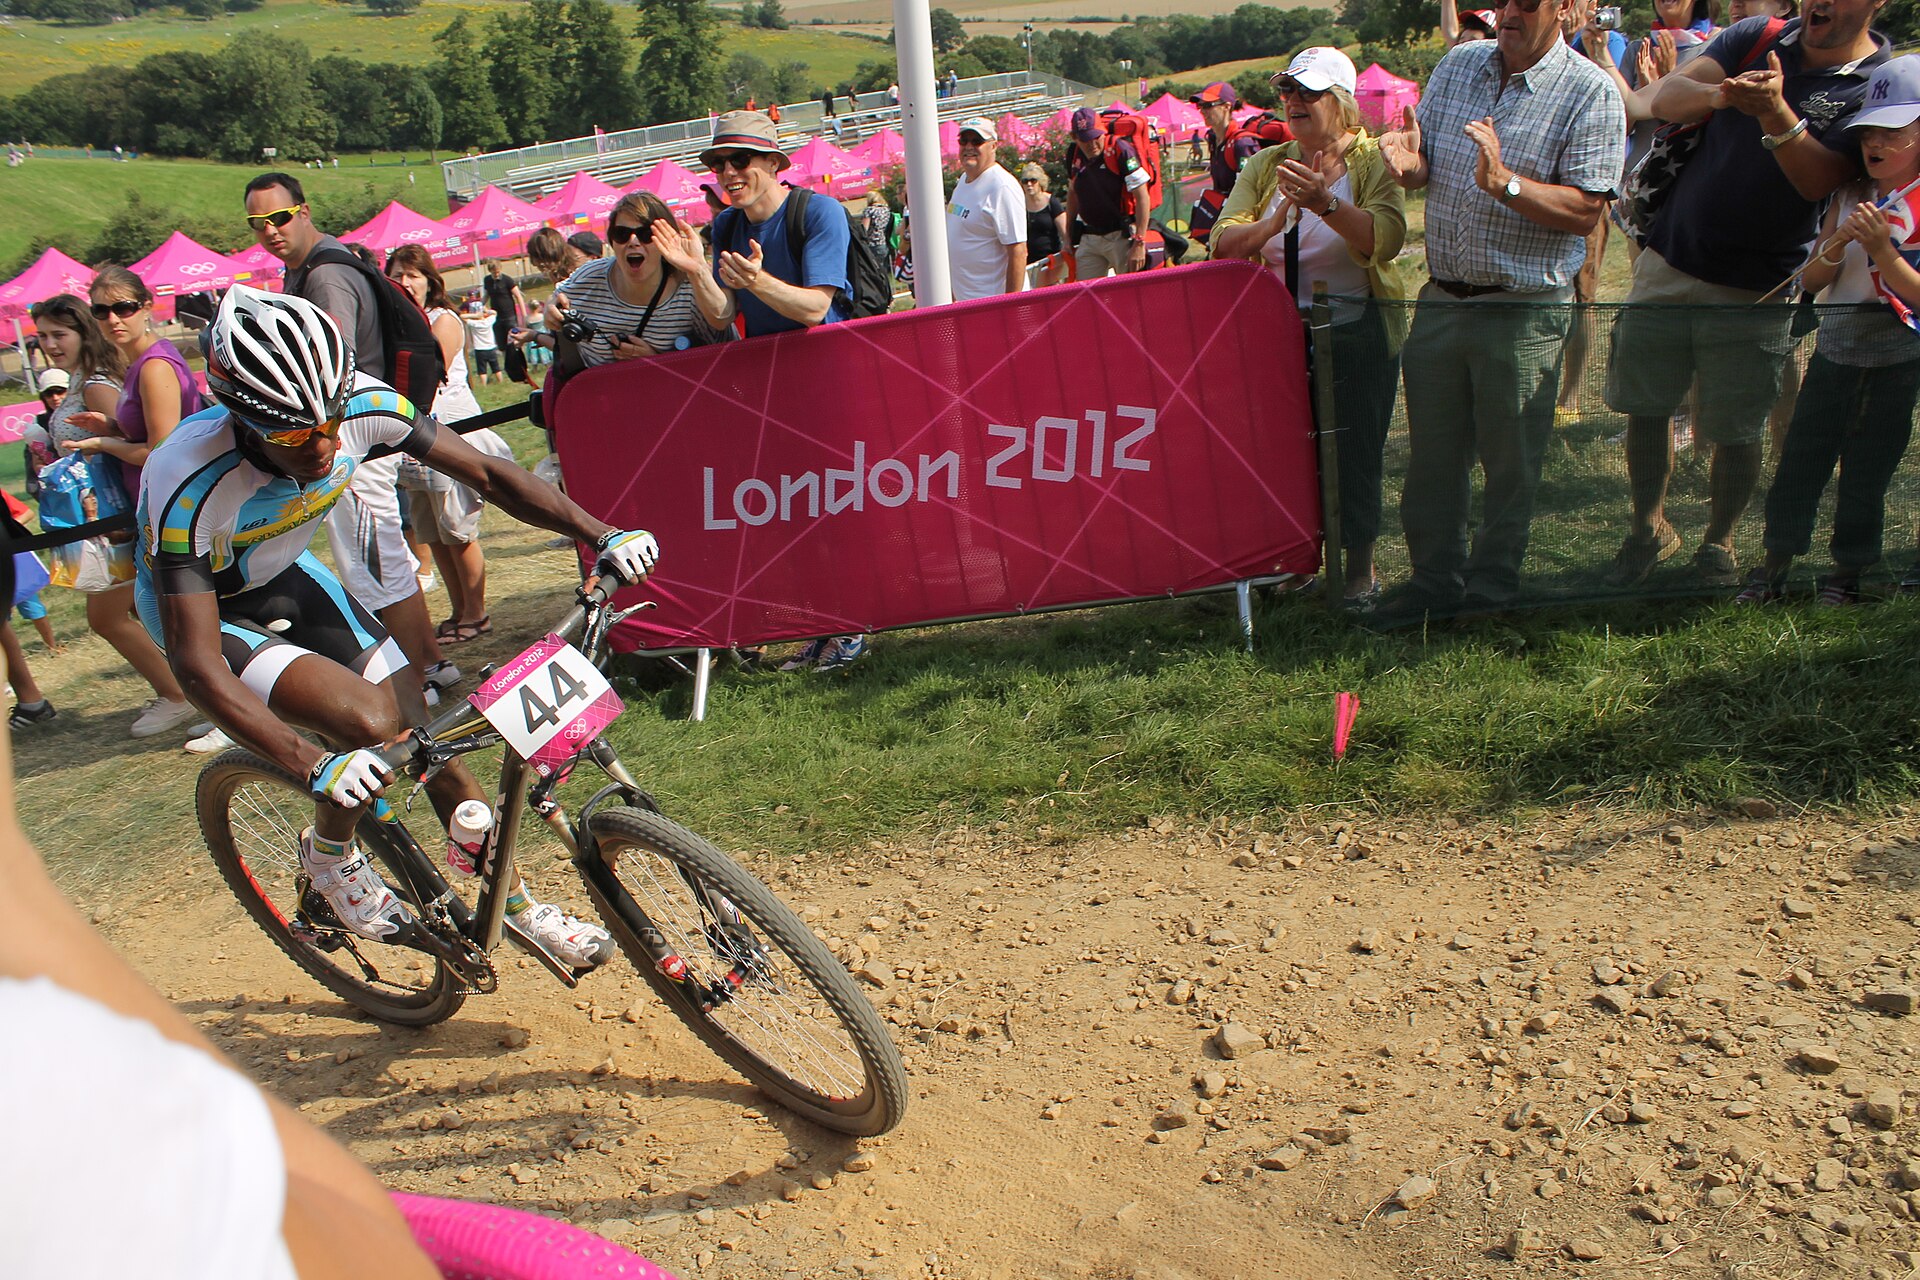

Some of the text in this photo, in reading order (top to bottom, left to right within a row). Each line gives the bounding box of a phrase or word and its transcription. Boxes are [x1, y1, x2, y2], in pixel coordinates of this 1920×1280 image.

[1871, 79, 1890, 99] NY
[502, 221, 540, 235] London 2012
[703, 404, 1157, 531] London 2012
[491, 648, 545, 692] London 2012
[518, 661, 589, 735] 44
[341, 858, 365, 878] SIDI
